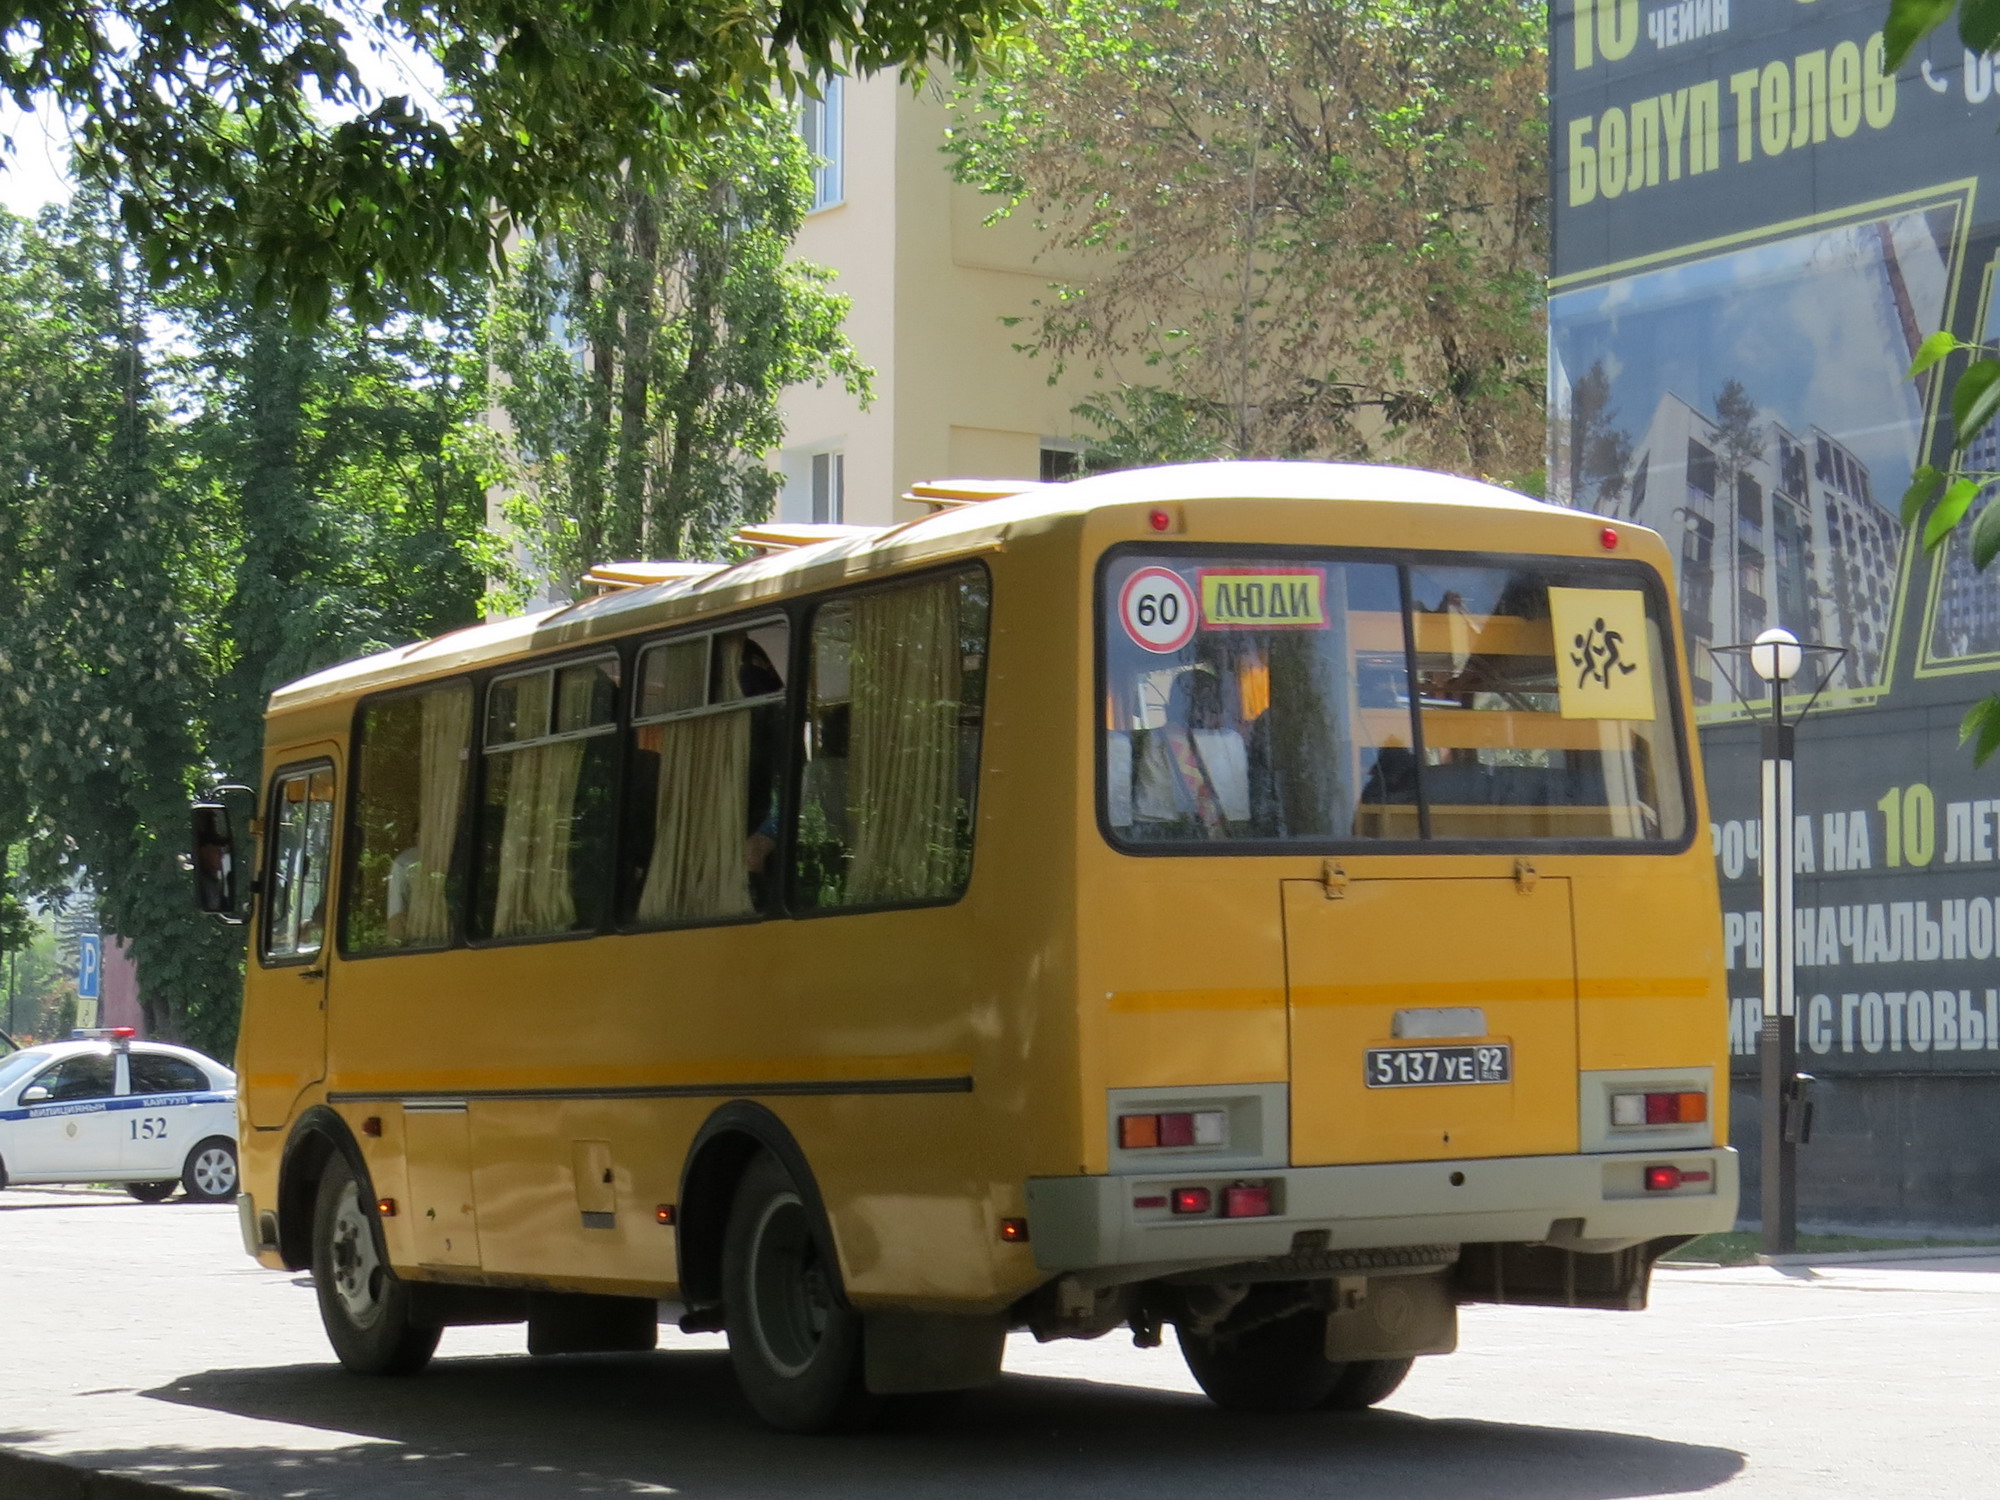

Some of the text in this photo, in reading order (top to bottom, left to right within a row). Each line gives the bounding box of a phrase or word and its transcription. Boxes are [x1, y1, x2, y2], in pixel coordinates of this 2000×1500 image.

[1138, 593, 1179, 627] 60
[1216, 582, 1311, 618] ЛЮДИ
[1823, 810, 1872, 873] НА
[1878, 783, 1935, 868] 10
[1809, 994, 1833, 1055] С
[1842, 989, 2000, 1055] ГОТОВЫ
[1376, 1051, 1440, 1083] 5137
[1479, 1049, 1502, 1071] 92
[130, 1118, 168, 1140] 152
